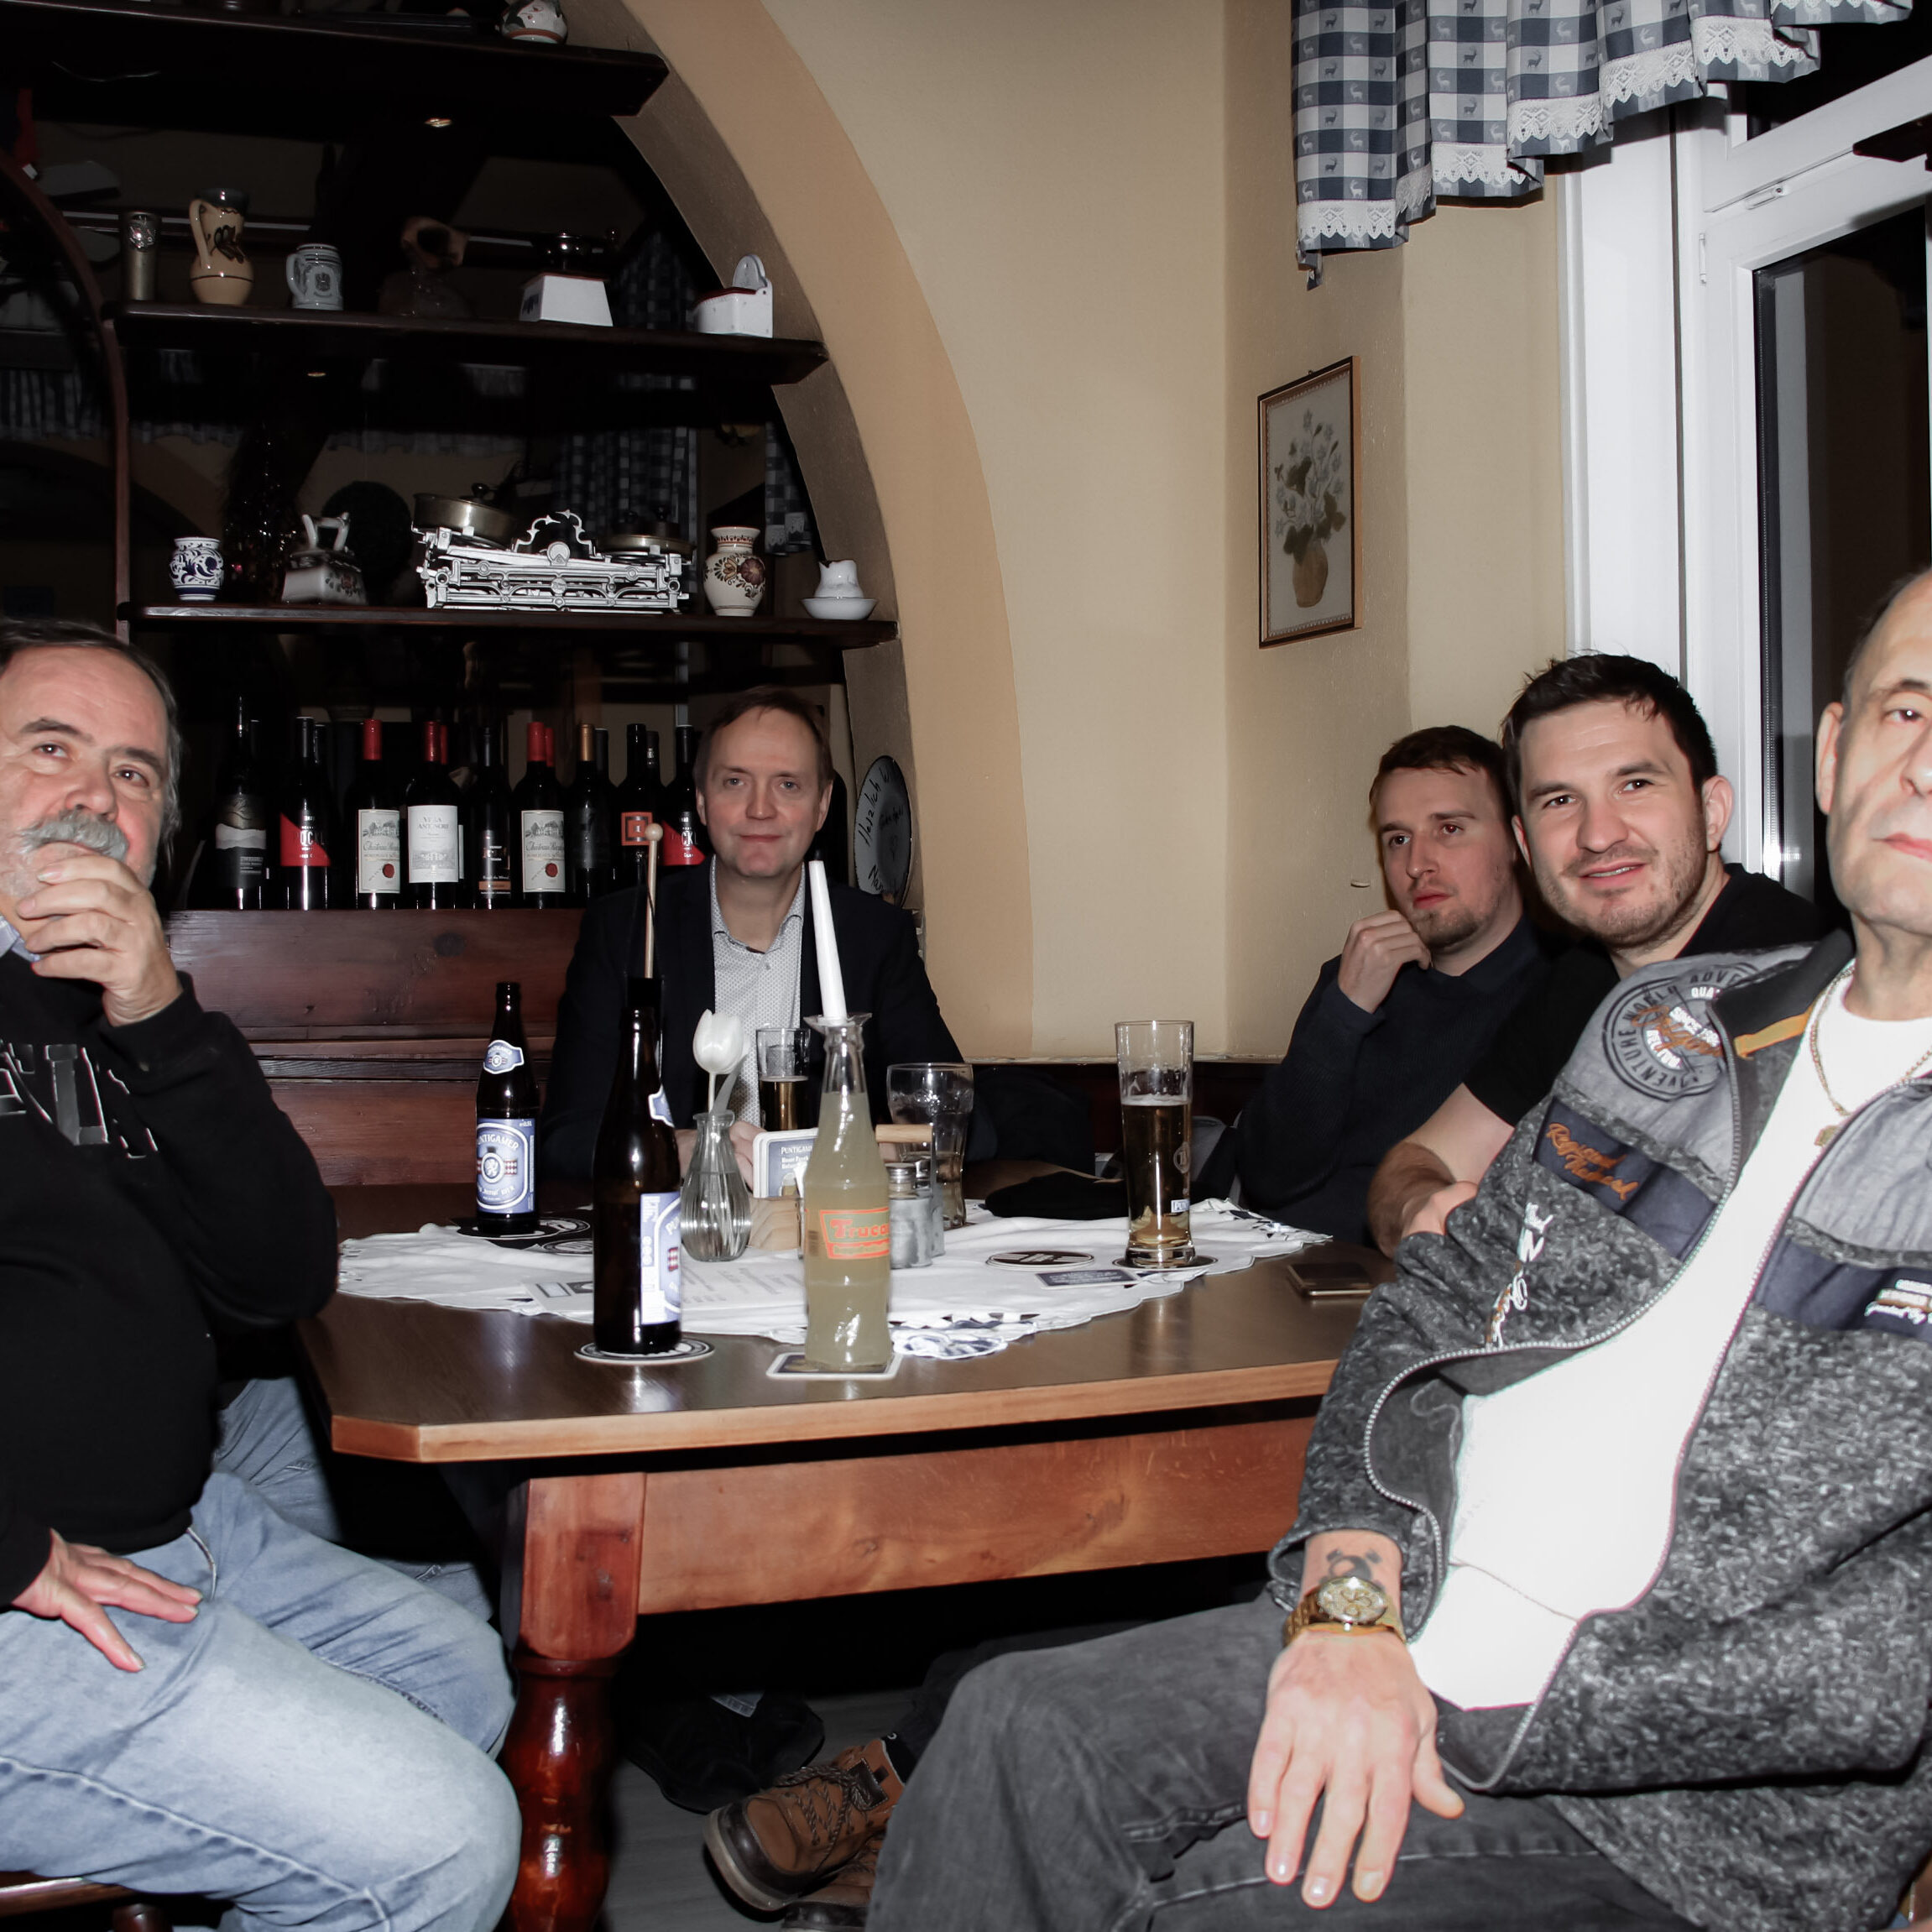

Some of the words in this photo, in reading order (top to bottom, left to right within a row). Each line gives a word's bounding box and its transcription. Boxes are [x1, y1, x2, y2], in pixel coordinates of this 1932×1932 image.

[1691, 986, 1721, 999] QUA
[1174, 1201, 1188, 1211] PUN
[829, 1218, 890, 1238] Truca
